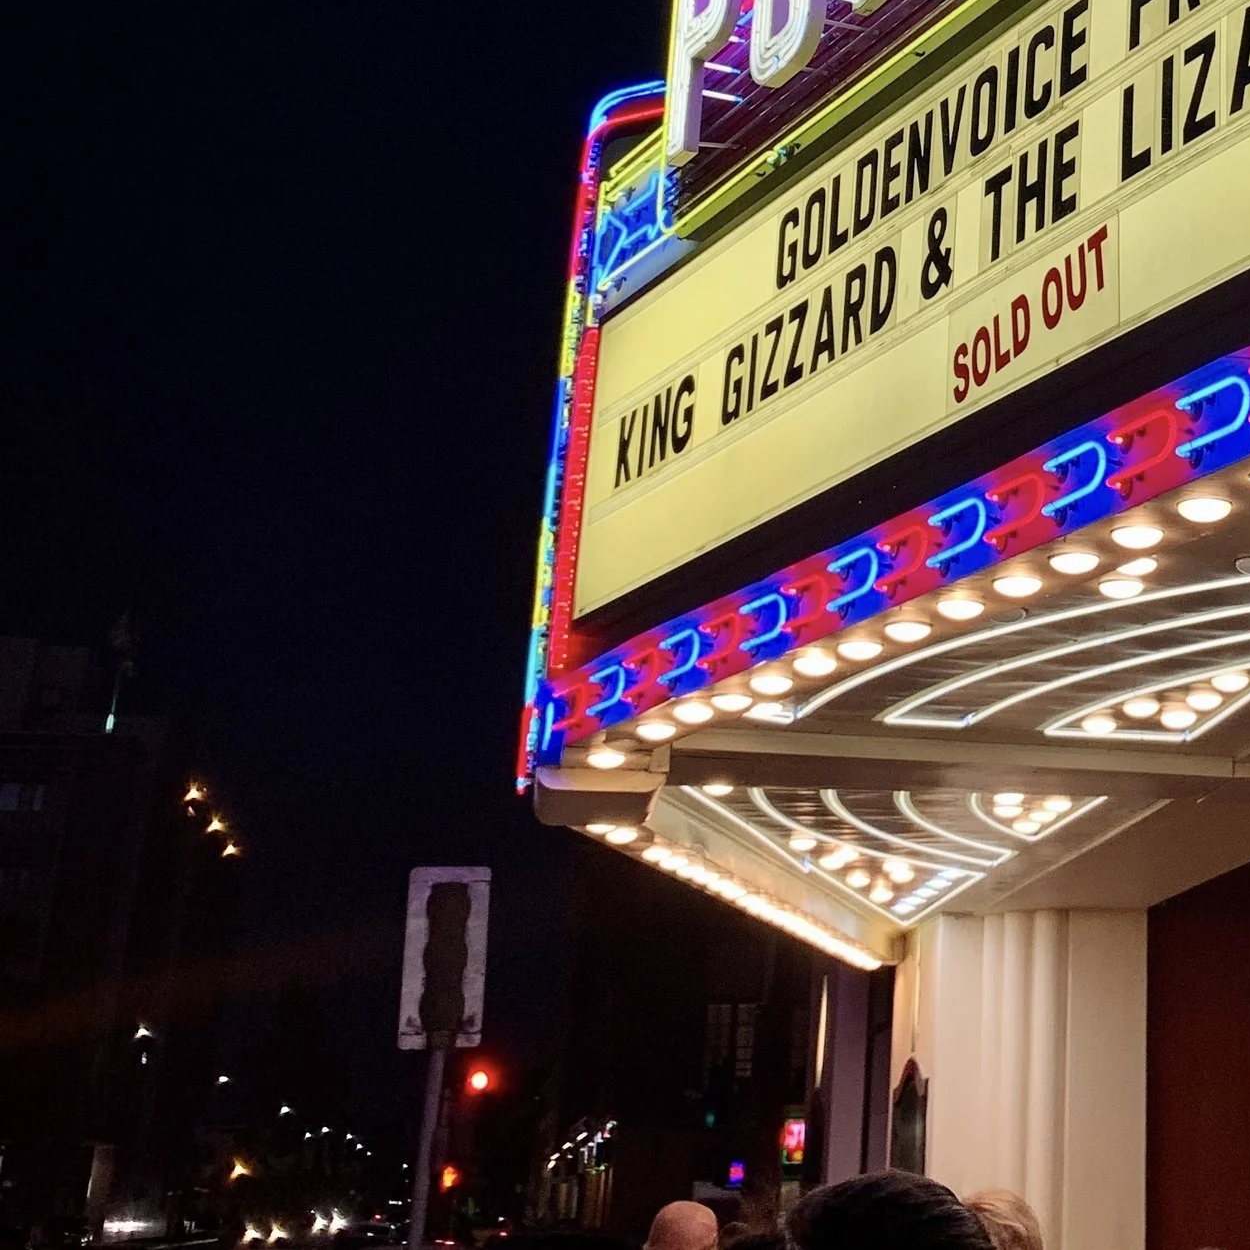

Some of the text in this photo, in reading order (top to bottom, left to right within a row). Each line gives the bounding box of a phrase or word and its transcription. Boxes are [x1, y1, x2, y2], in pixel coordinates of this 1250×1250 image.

[614, 374, 695, 488] KING
[721, 246, 897, 425] GIZZARD
[920, 207, 953, 299] &
[984, 120, 1079, 264] THE
[953, 225, 1108, 403] SOLD OUT
